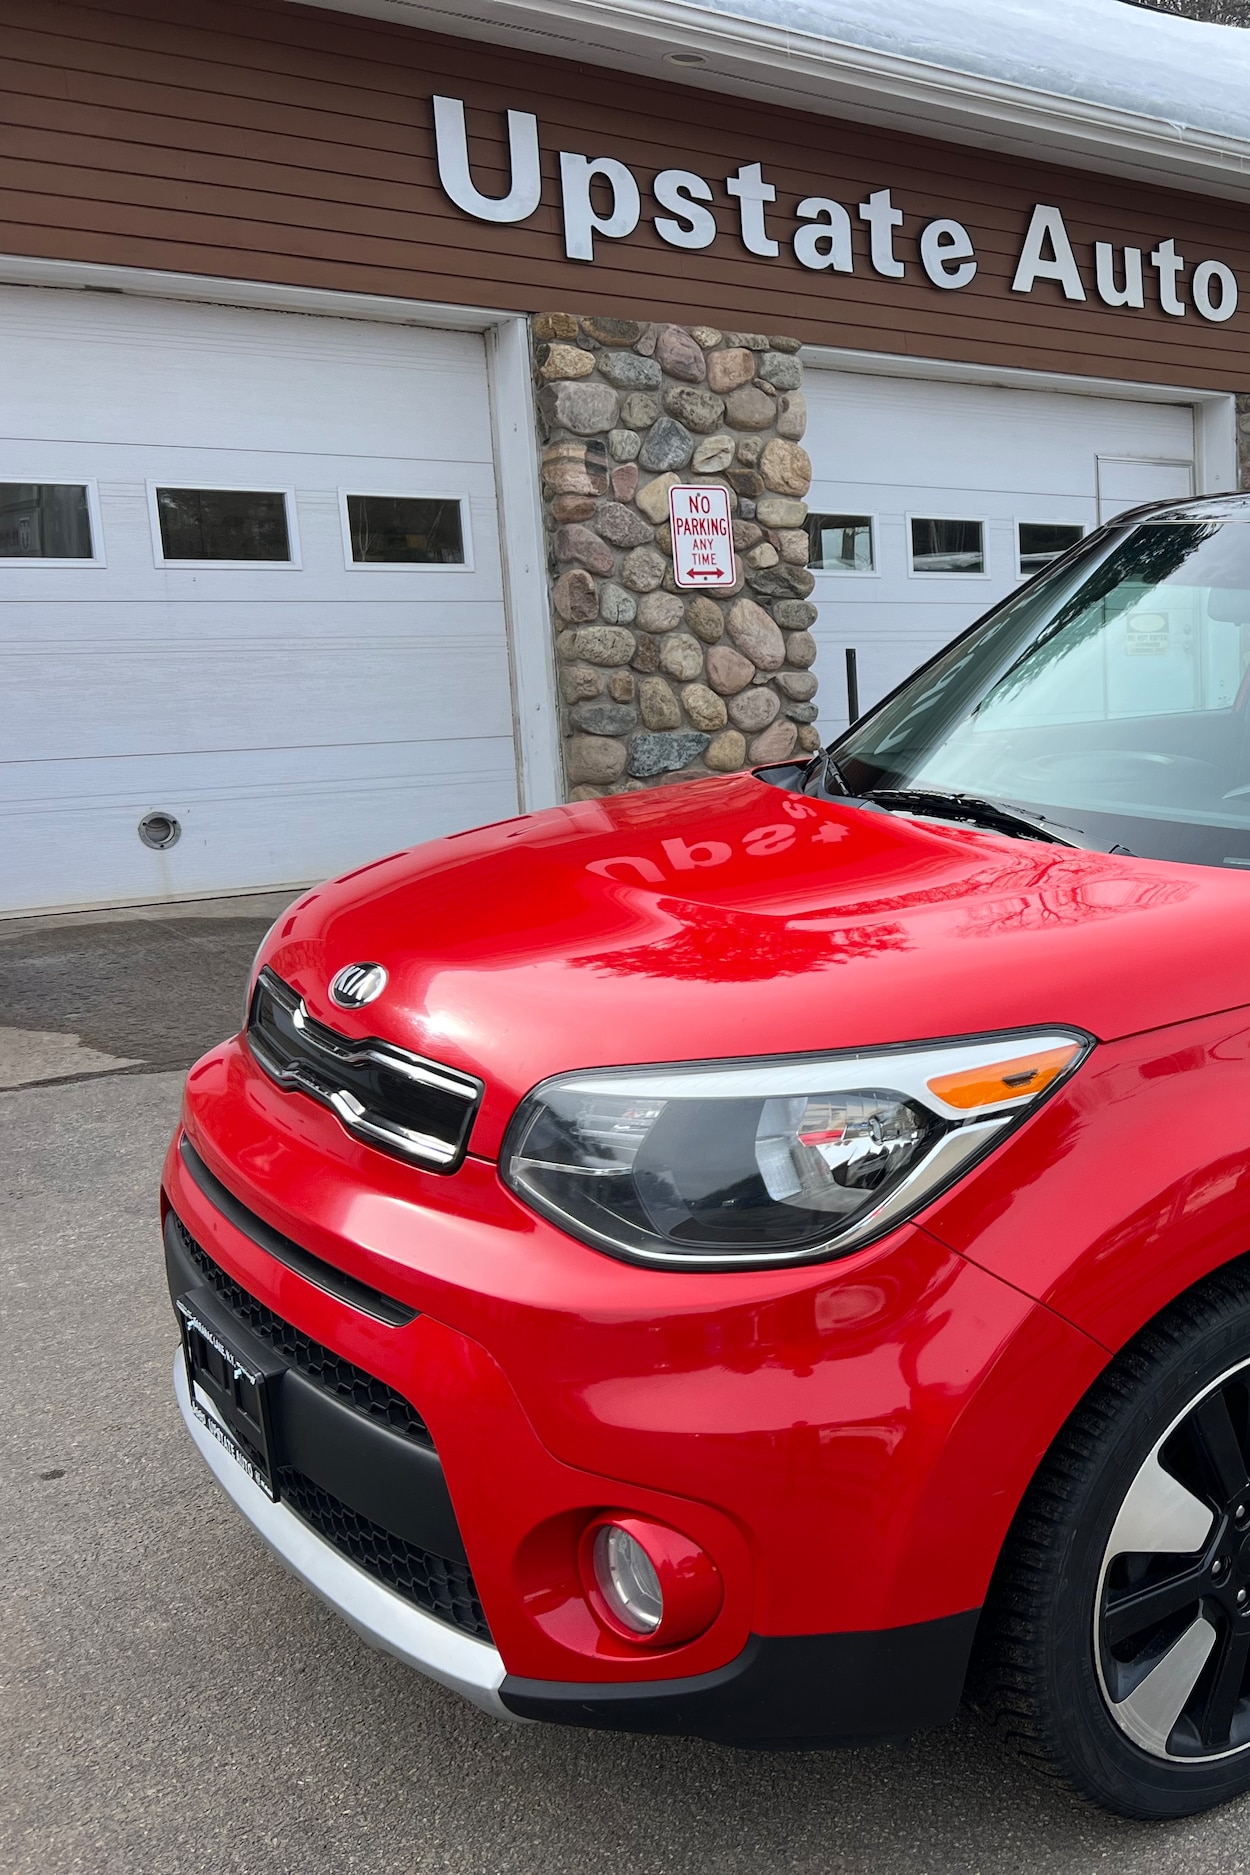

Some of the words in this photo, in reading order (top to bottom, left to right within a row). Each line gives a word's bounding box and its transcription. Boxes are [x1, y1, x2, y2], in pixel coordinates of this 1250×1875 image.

[432, 94, 978, 291] Upstate
[1011, 203, 1239, 322] Auto
[688, 495, 711, 514] NO
[676, 517, 728, 536] PARKING
[692, 538, 714, 551] ANY
[691, 553, 718, 566] TIME
[207, 1417, 236, 1459] UPSTATE
[235, 1448, 254, 1480] AUTO
